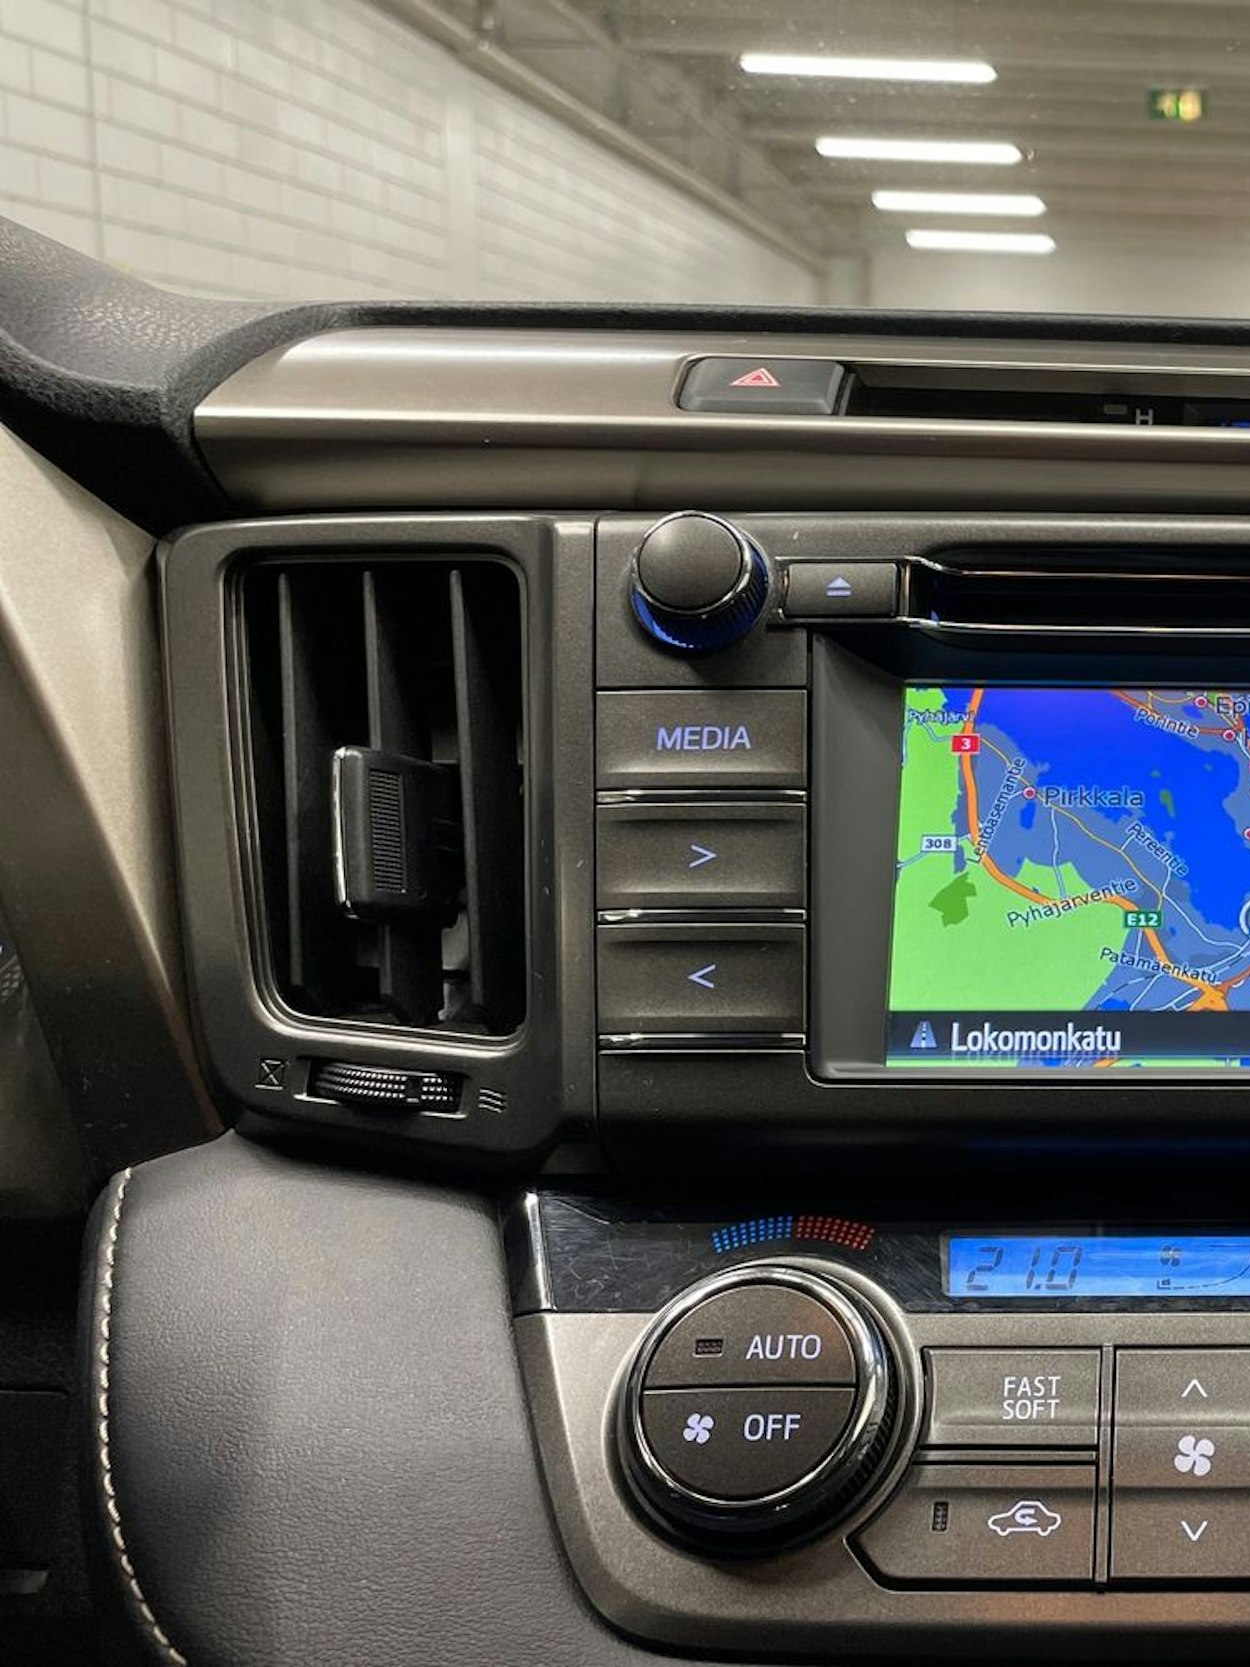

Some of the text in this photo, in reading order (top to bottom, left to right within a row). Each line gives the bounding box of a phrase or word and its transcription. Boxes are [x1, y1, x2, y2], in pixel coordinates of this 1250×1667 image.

[656, 726, 751, 751] MEDIA
[961, 738, 972, 749] 3
[1044, 787, 1144, 807] Pirkkala
[925, 838, 952, 850] 308
[1127, 914, 1158, 926] E12
[951, 1023, 1122, 1052] Lokomonkatu
[966, 1246, 1082, 1291] 21.0
[746, 1335, 822, 1359] AUTO
[1003, 1376, 1061, 1397] FAST
[1002, 1400, 1060, 1420] SOFT
[743, 1414, 801, 1441] OFF
